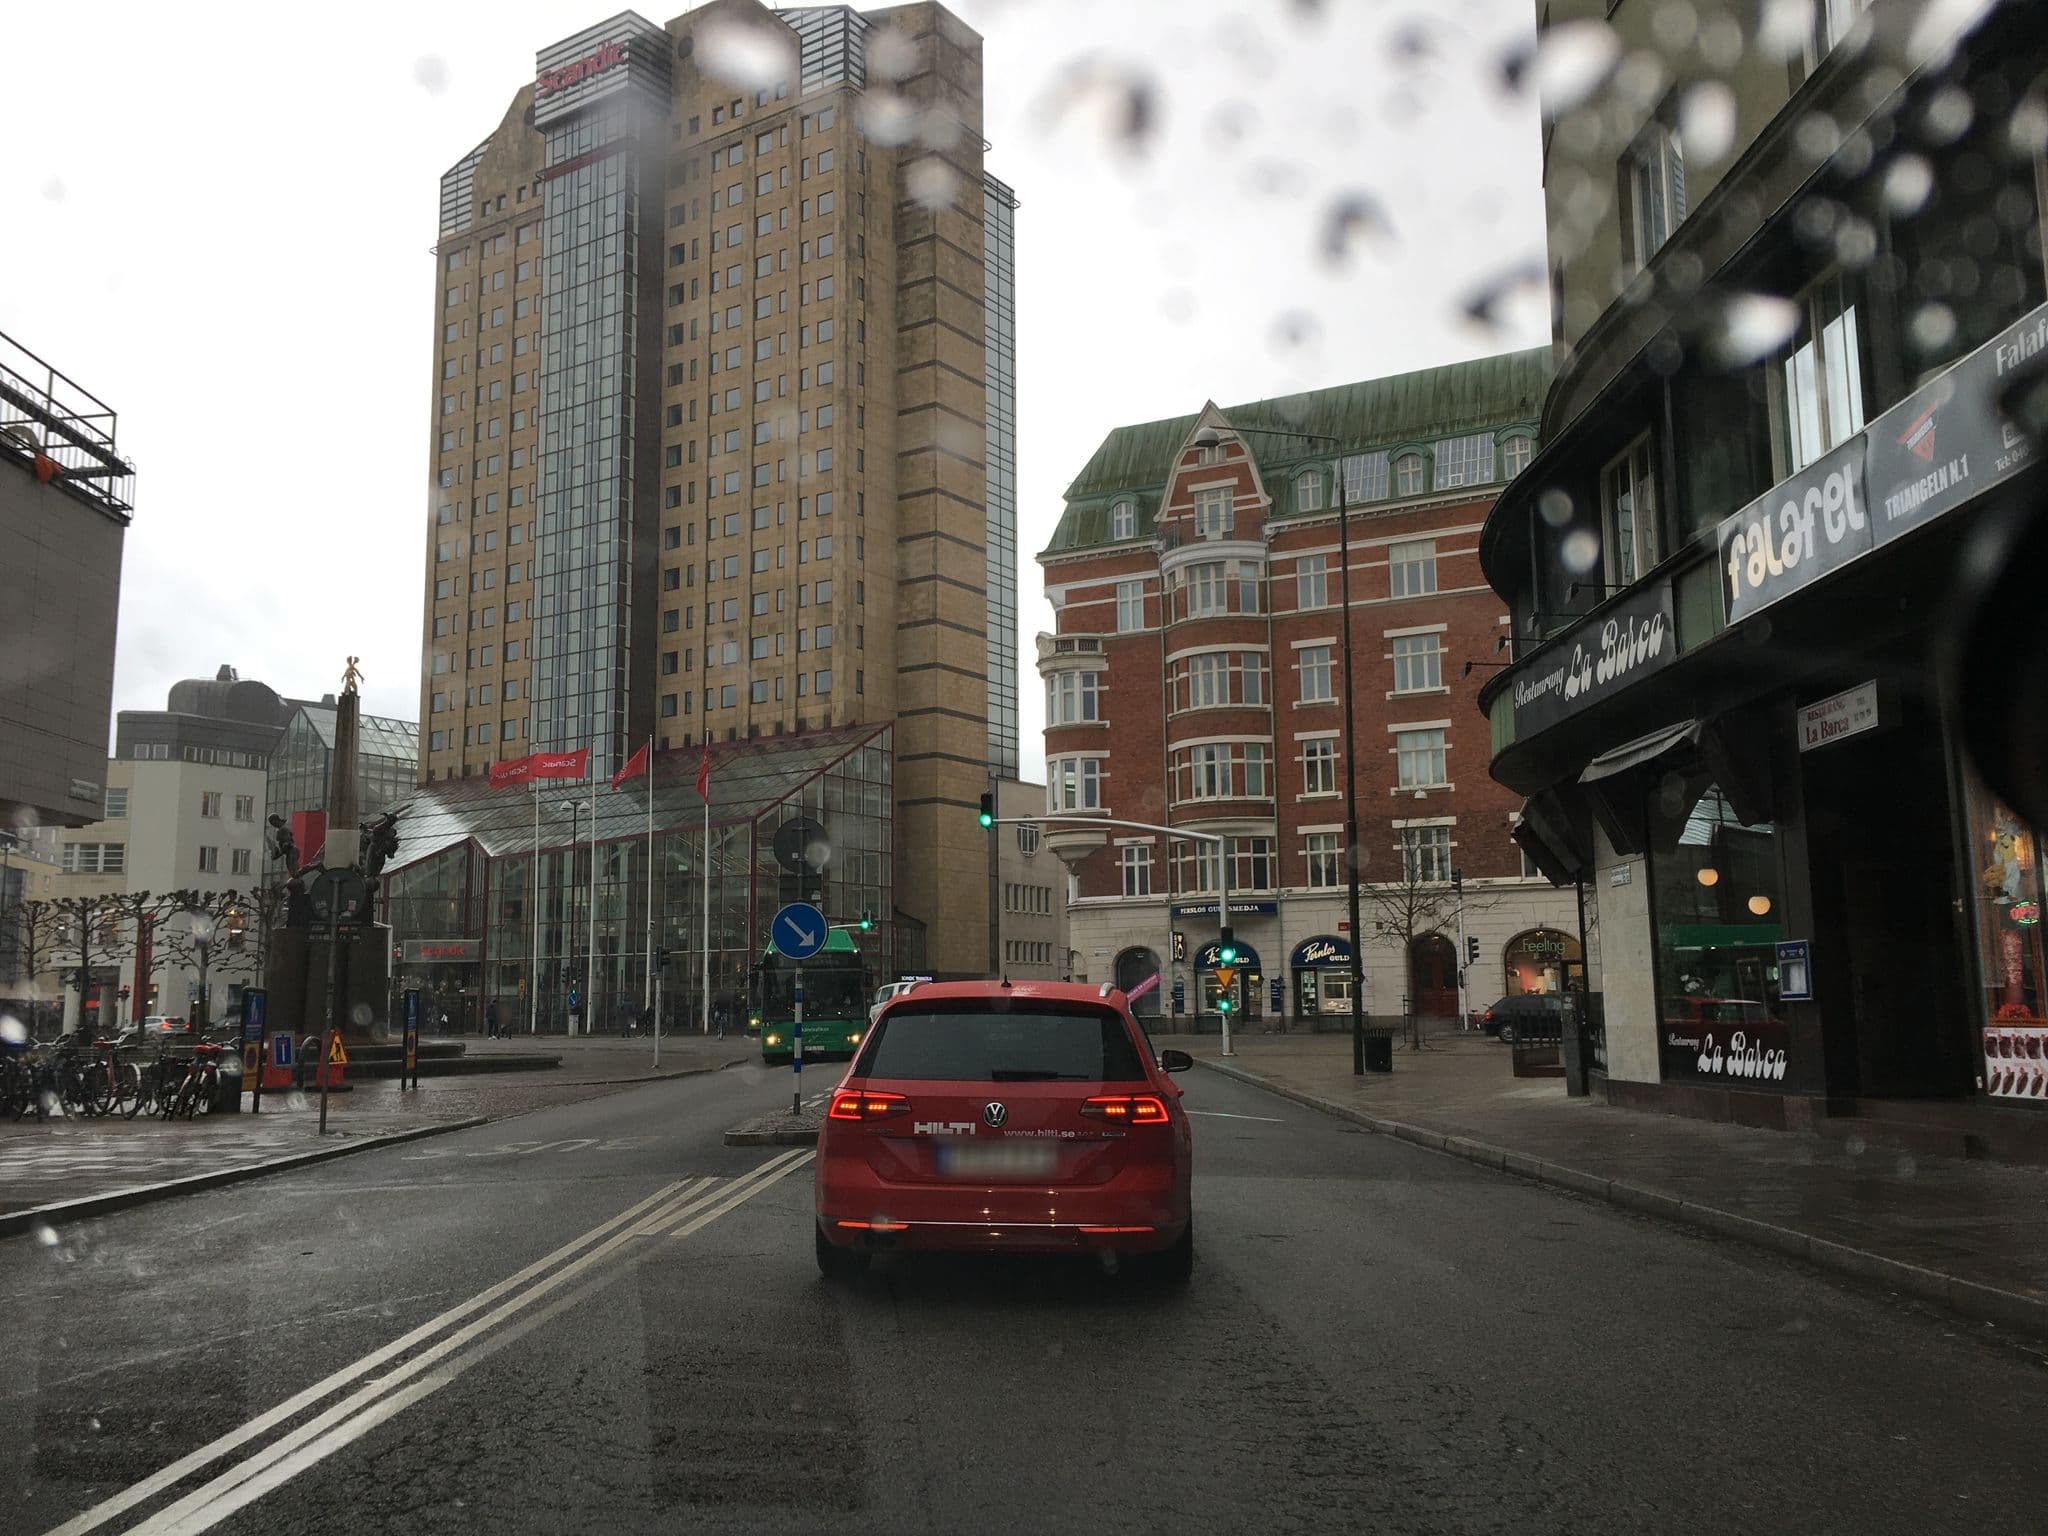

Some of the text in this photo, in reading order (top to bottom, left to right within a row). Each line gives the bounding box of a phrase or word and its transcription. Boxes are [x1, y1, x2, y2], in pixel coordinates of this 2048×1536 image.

[535, 39, 625, 97] Scandic
[1996, 318, 2048, 376] Falaf
[1885, 453, 1969, 521] TRIANGELN N.1
[1515, 612, 1665, 710] Restaurang La Barca
[1697, 1033, 1723, 1074] La
[1726, 1031, 1787, 1081] Barca
[914, 1121, 976, 1135] HILTI
[1003, 1128, 1076, 1139] www.hilti.se
